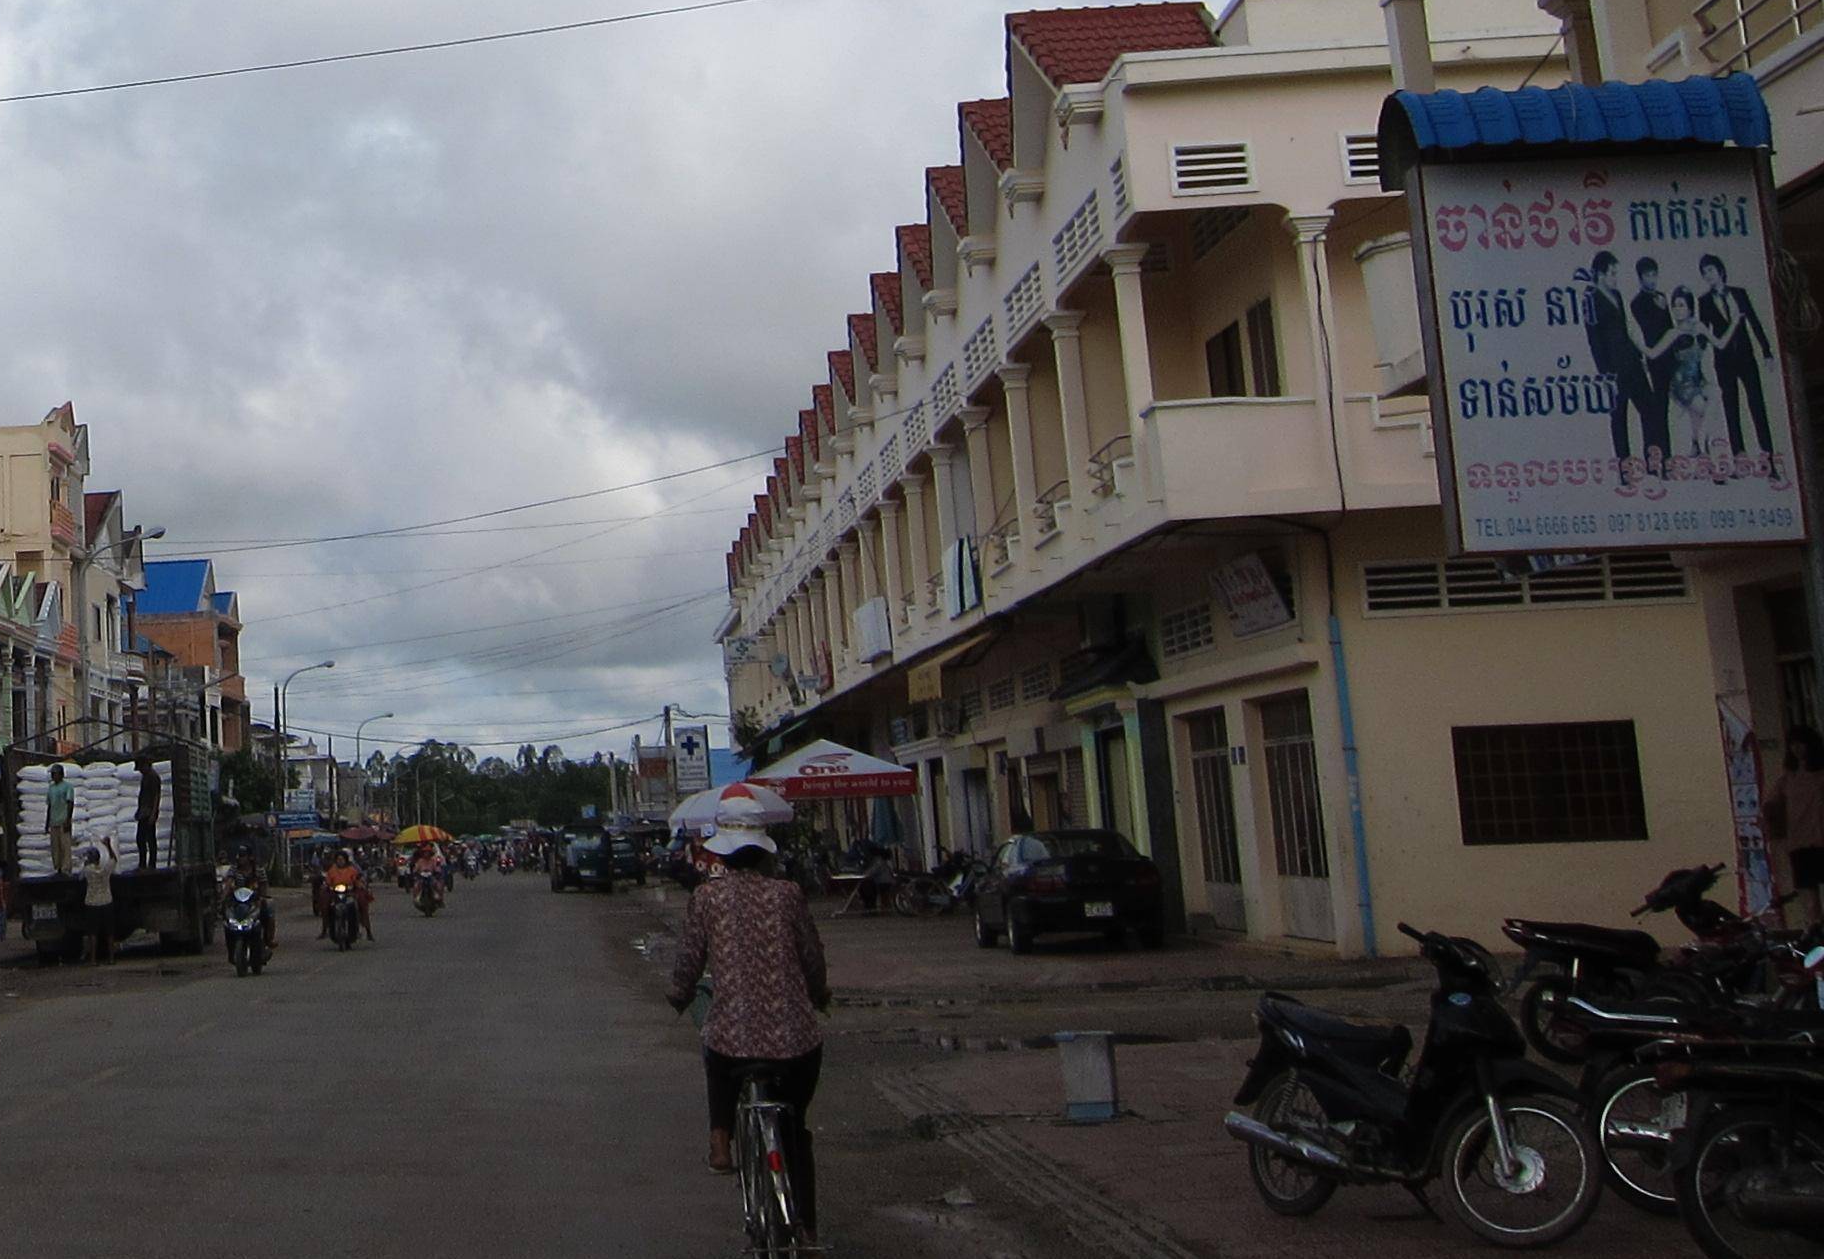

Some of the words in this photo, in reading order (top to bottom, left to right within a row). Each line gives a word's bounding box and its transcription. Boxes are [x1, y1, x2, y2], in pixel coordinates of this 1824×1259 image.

[1450, 287, 1526, 353] បុរស
[1459, 355, 1618, 419] ទាន់សម័យ
[1476, 518, 1503, 537] TEL
[802, 780, 832, 791] brings
[833, 779, 849, 789] the
[851, 778, 878, 789] world
[893, 778, 911, 790] you
